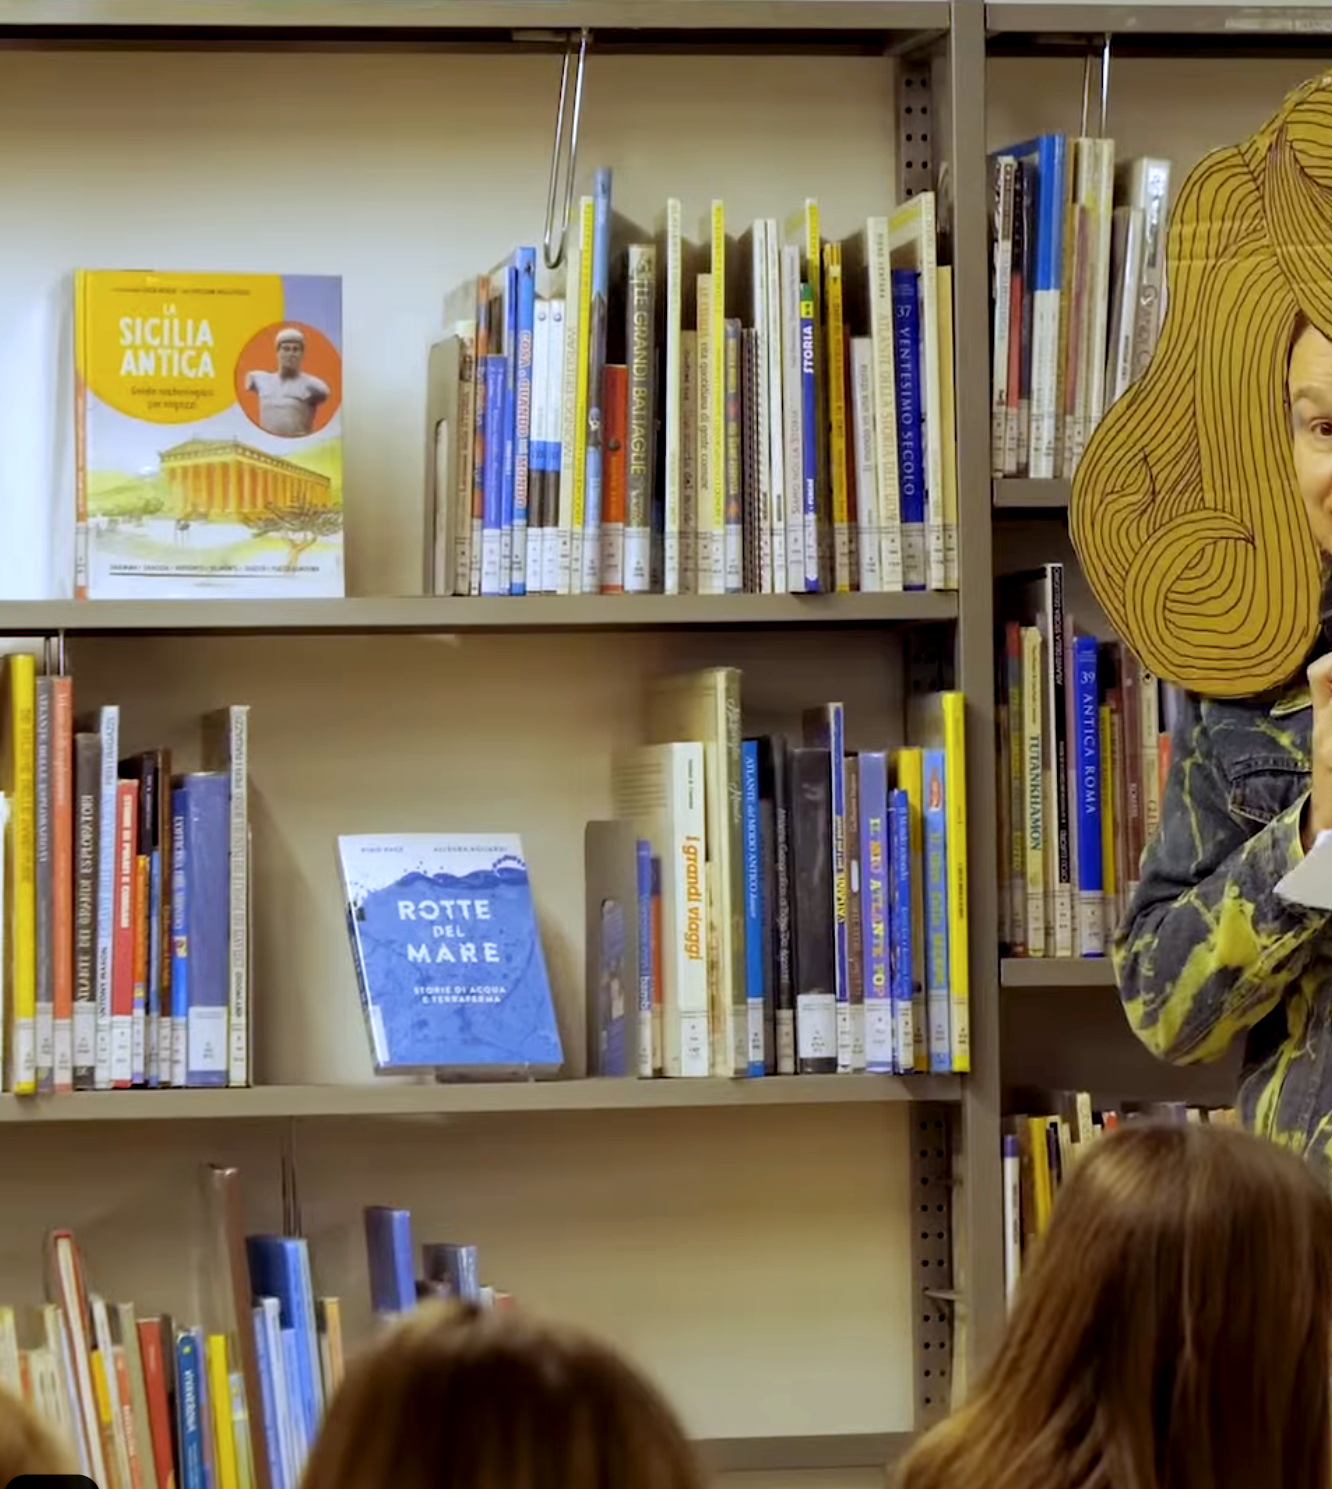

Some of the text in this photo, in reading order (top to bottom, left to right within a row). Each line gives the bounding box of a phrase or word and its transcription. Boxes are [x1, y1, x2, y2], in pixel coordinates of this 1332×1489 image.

[163, 303, 177, 316] LA
[897, 304, 912, 318] 37
[119, 317, 214, 347] SICILIA
[518, 330, 531, 368] COSA
[631, 311, 647, 381] GRANDI
[700, 341, 709, 359] vita
[802, 325, 815, 374] STORIA
[879, 312, 892, 364] ATLANTE
[119, 348, 215, 378] ANTICA
[699, 361, 710, 410] quotidiana
[630, 387, 646, 475] BATTAGLIE
[899, 327, 916, 496] VENTESIMO SECOLO
[699, 425, 710, 450] gente
[881, 412, 895, 457] STORIA
[1080, 670, 1095, 684] 39
[37, 693, 48, 738] ATLANTE
[1083, 693, 1097, 814] ANTICA ROMA
[746, 756, 756, 802] ATLANTE
[1029, 736, 1042, 851] TUTANKHAMON
[80, 795, 94, 873] ESPLORATORI
[683, 844, 701, 903] grandi
[749, 853, 758, 891] ANTICO
[79, 880, 93, 924] GRANDI
[398, 899, 491, 920] ROTTE
[869, 879, 884, 957] ATLANTE
[407, 942, 501, 963] MARE
[432, 925, 465, 938] DEL
[684, 906, 703, 960] viaggi
[413, 986, 451, 994] STORIE
[469, 986, 507, 994] ACQUA
[432, 995, 501, 1004] TERRAFERMA
